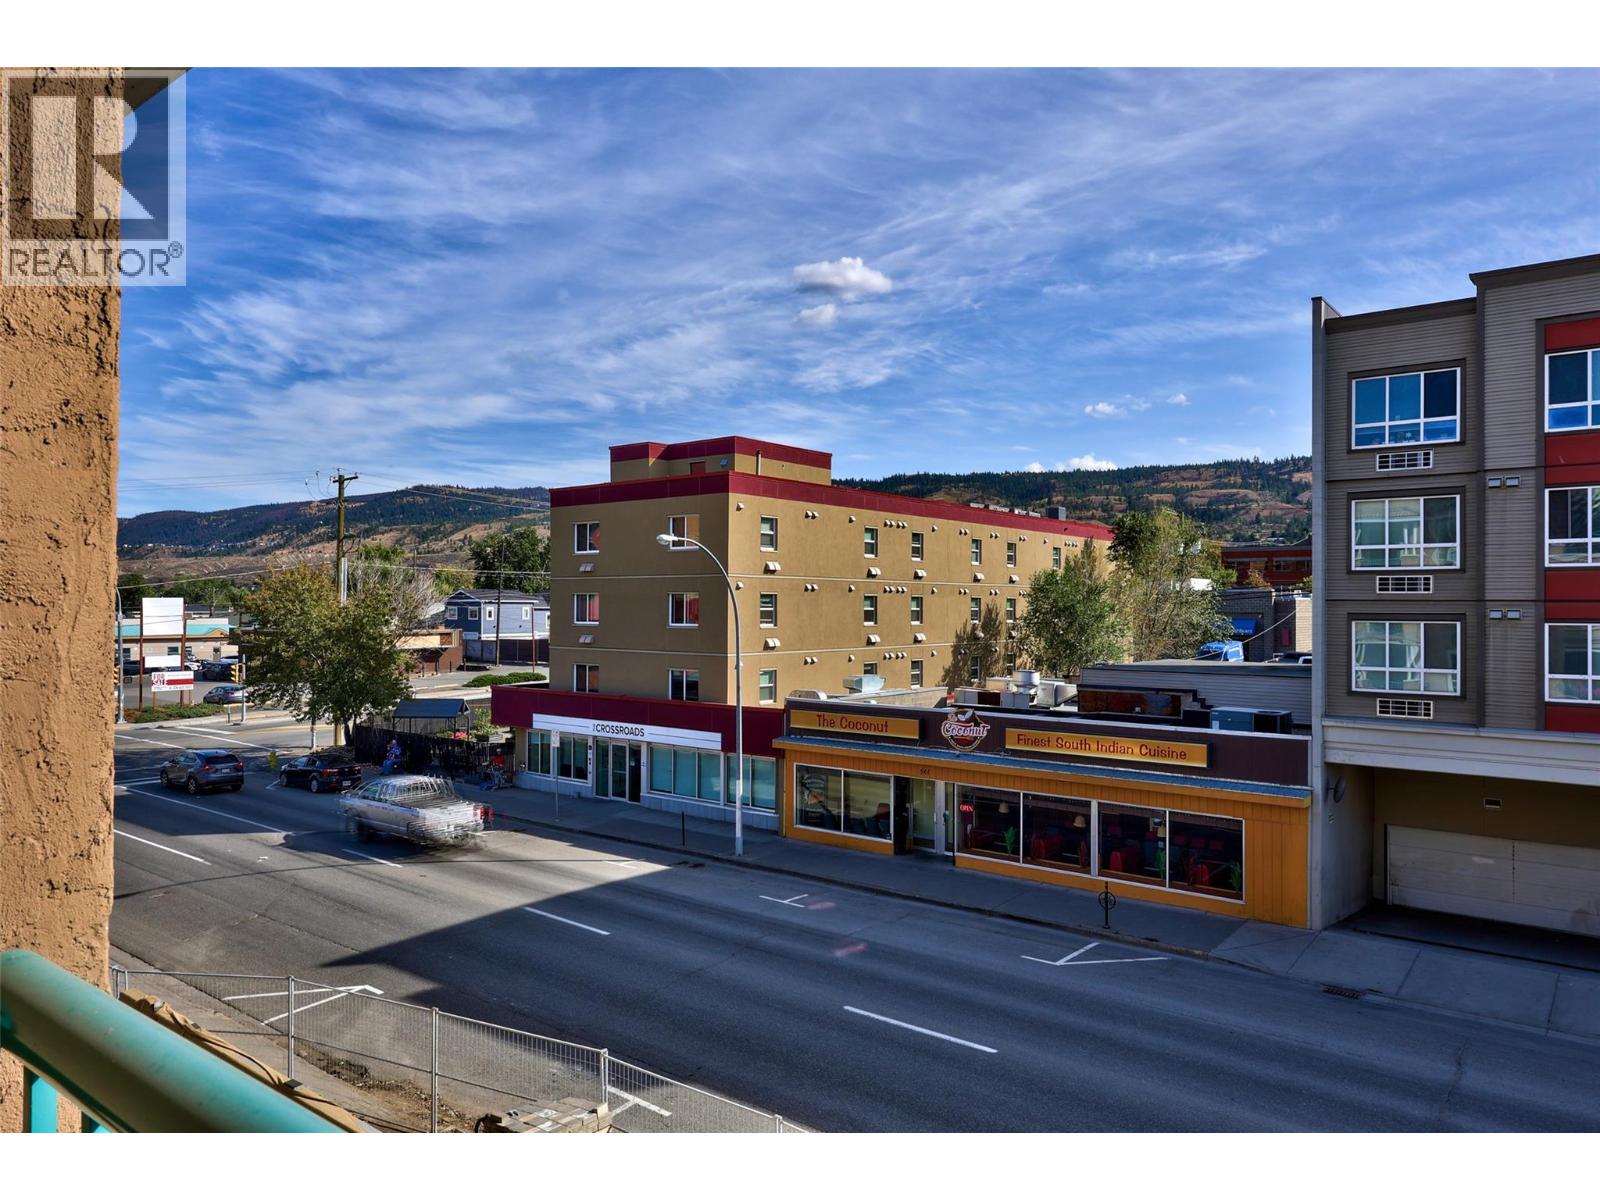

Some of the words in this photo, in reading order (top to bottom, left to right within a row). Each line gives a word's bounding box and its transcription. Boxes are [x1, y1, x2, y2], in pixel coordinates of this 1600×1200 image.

[595, 723, 645, 737] CROSSROADS
[816, 713, 835, 728] The
[840, 716, 888, 733] Coconut
[942, 721, 991, 737] Coconut
[1017, 733, 1051, 747] Finest
[1056, 736, 1091, 751] South
[1096, 740, 1134, 755] Indian
[1139, 743, 1187, 760] Cuisine
